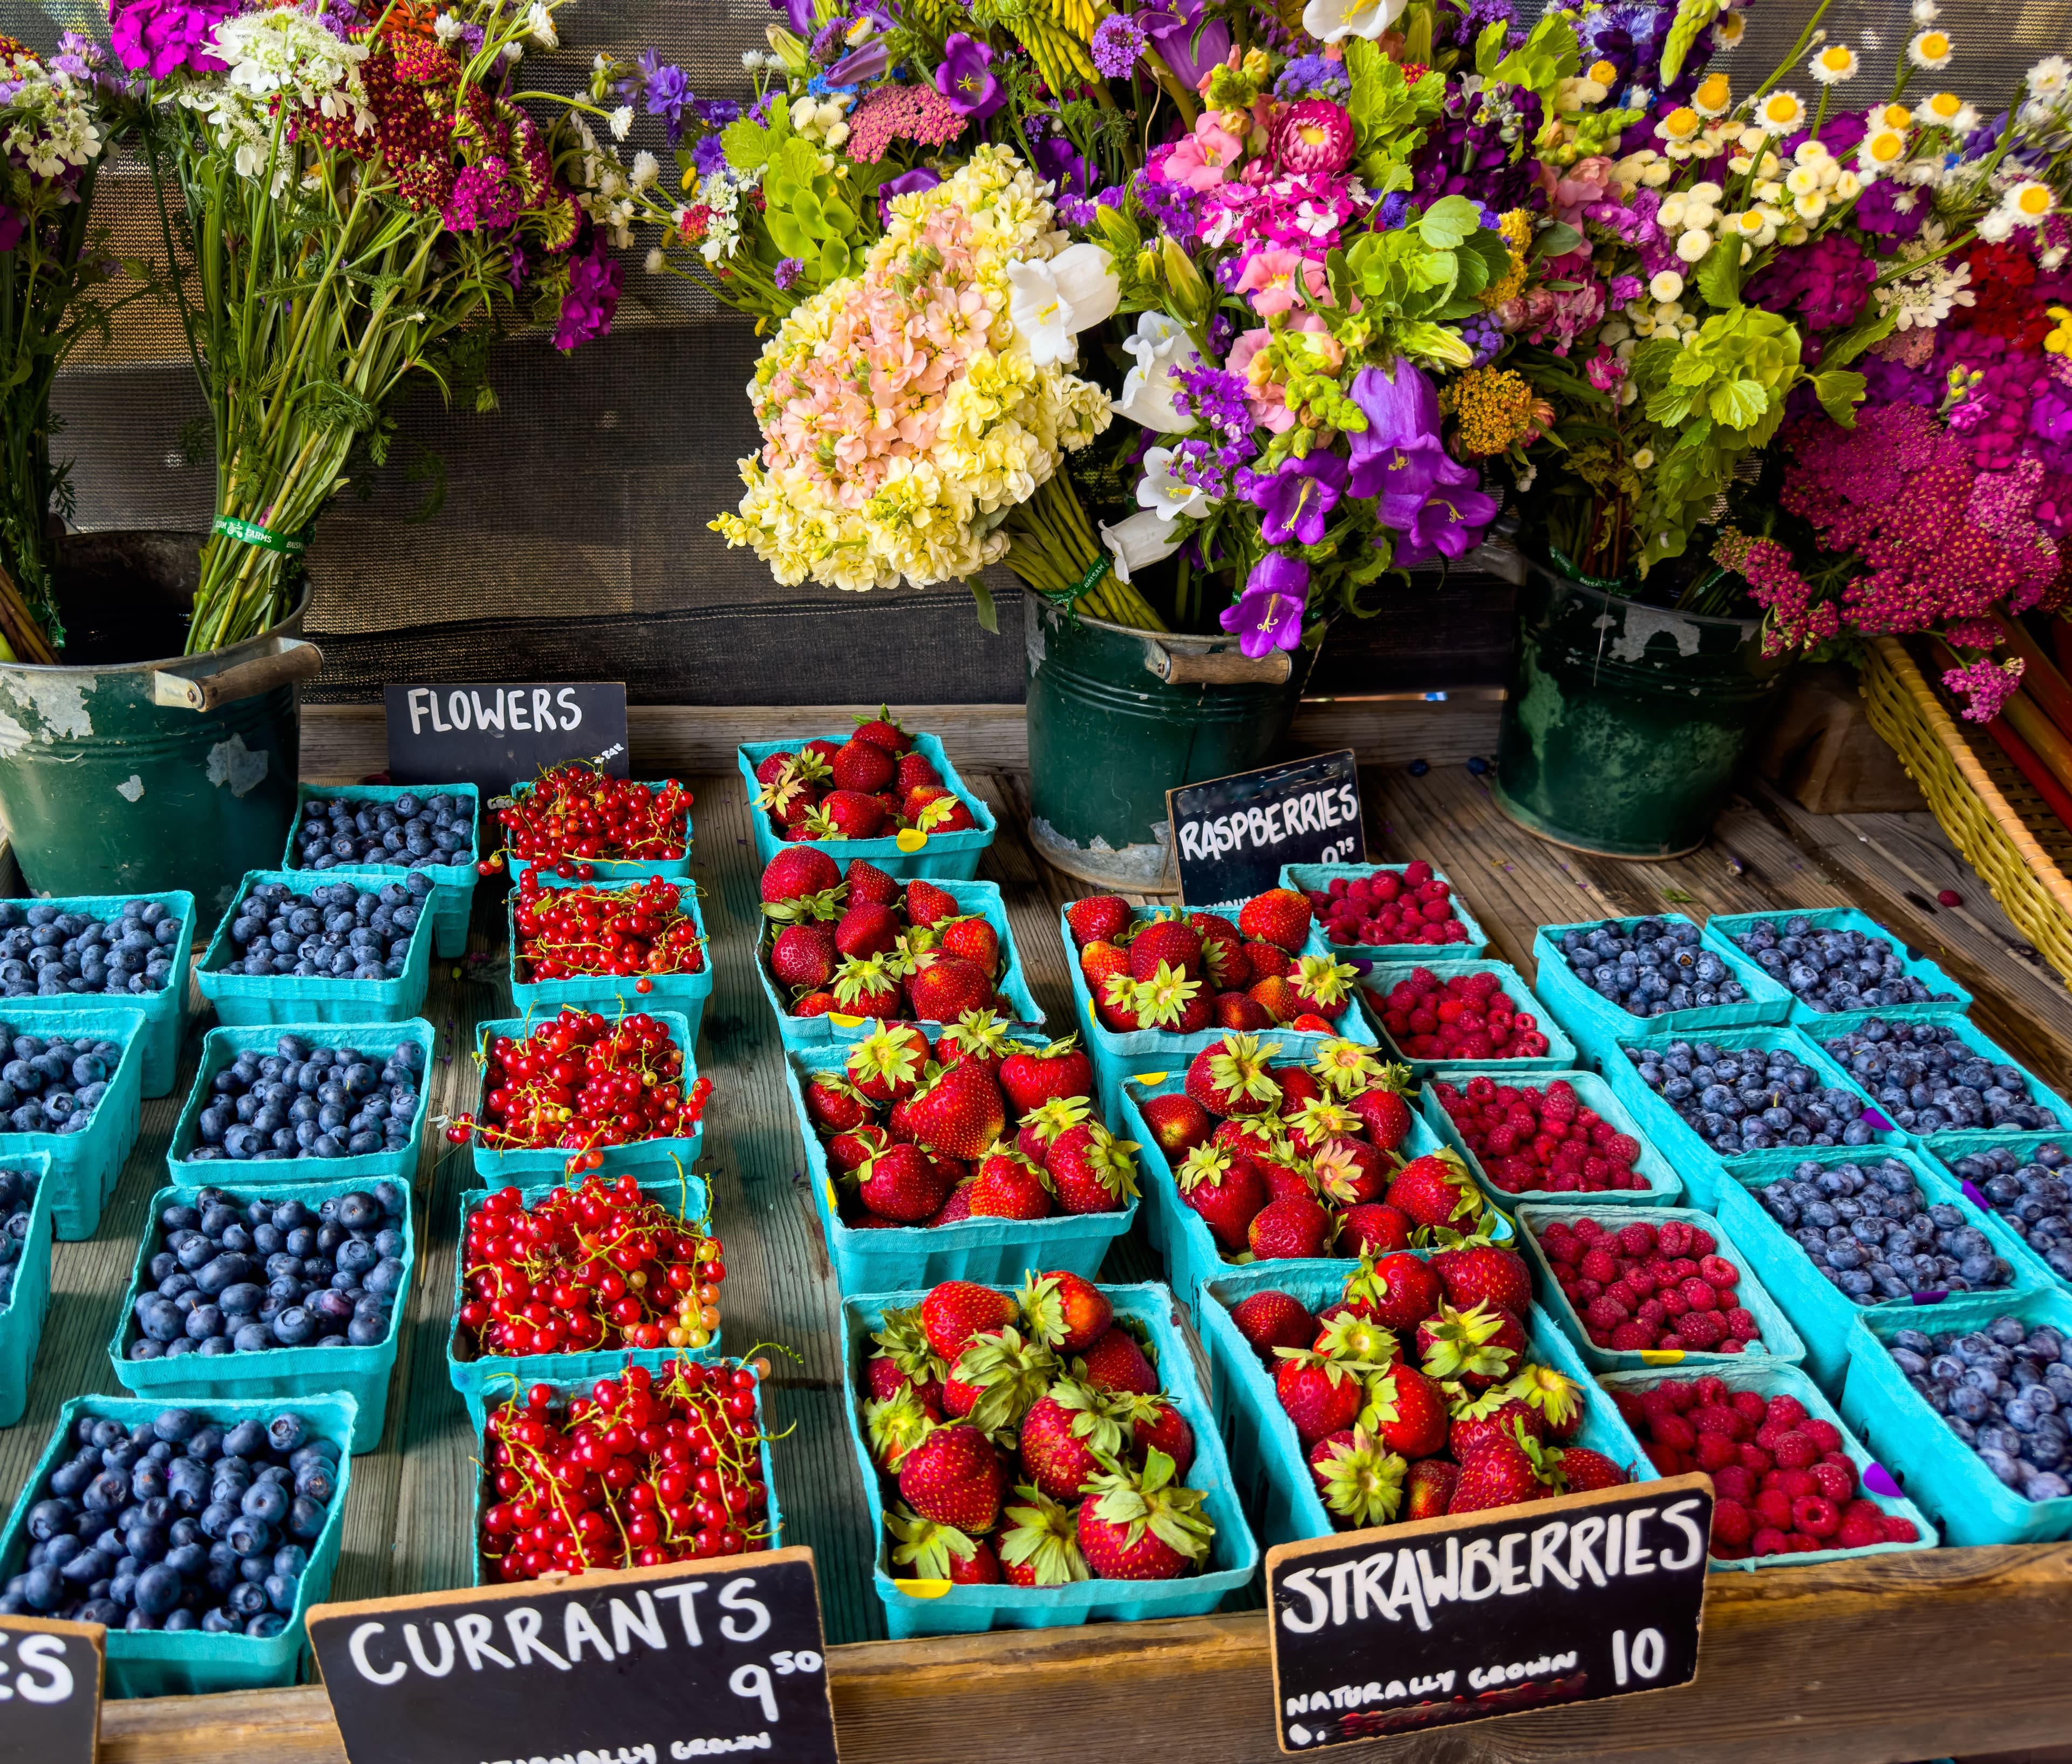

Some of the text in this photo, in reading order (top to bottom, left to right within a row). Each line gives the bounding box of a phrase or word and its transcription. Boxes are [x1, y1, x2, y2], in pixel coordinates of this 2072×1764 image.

[246, 529, 272, 543] FARMS
[1084, 564, 1105, 588] BALSAM
[407, 687, 582, 734] FLOWERS
[1179, 784, 1358, 862] RASPBERRIES
[1282, 1499, 1702, 1633] STRAWBERRIES
[349, 1577, 771, 1686] CURRANTS
[1612, 1628, 1665, 1685] 10
[1286, 1651, 1577, 1717] NATURALLY GROWN
[671, 1732, 771, 1760] GROWN
